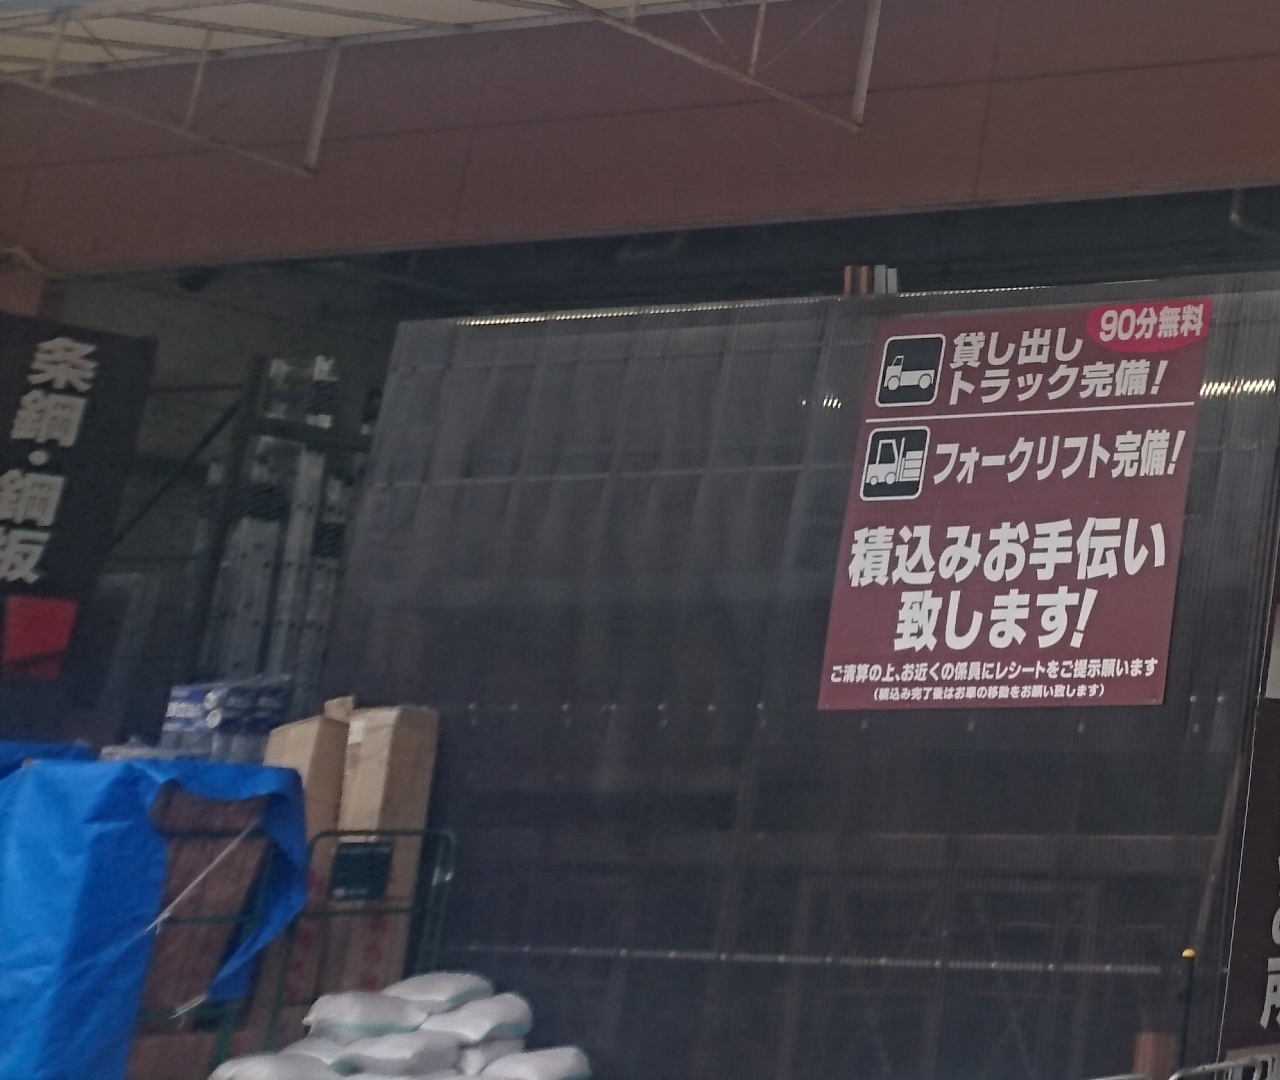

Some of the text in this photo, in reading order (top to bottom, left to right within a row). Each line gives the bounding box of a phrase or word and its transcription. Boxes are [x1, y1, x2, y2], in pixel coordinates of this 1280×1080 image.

[1098, 304, 1206, 342] 90分無料
[949, 328, 1084, 370] 貸し出し
[949, 359, 1168, 405] トラック完備!
[932, 430, 1186, 485] フォークリフト完備!
[848, 517, 1167, 588] 積込みお手伝い
[893, 585, 1099, 653] 致します!
